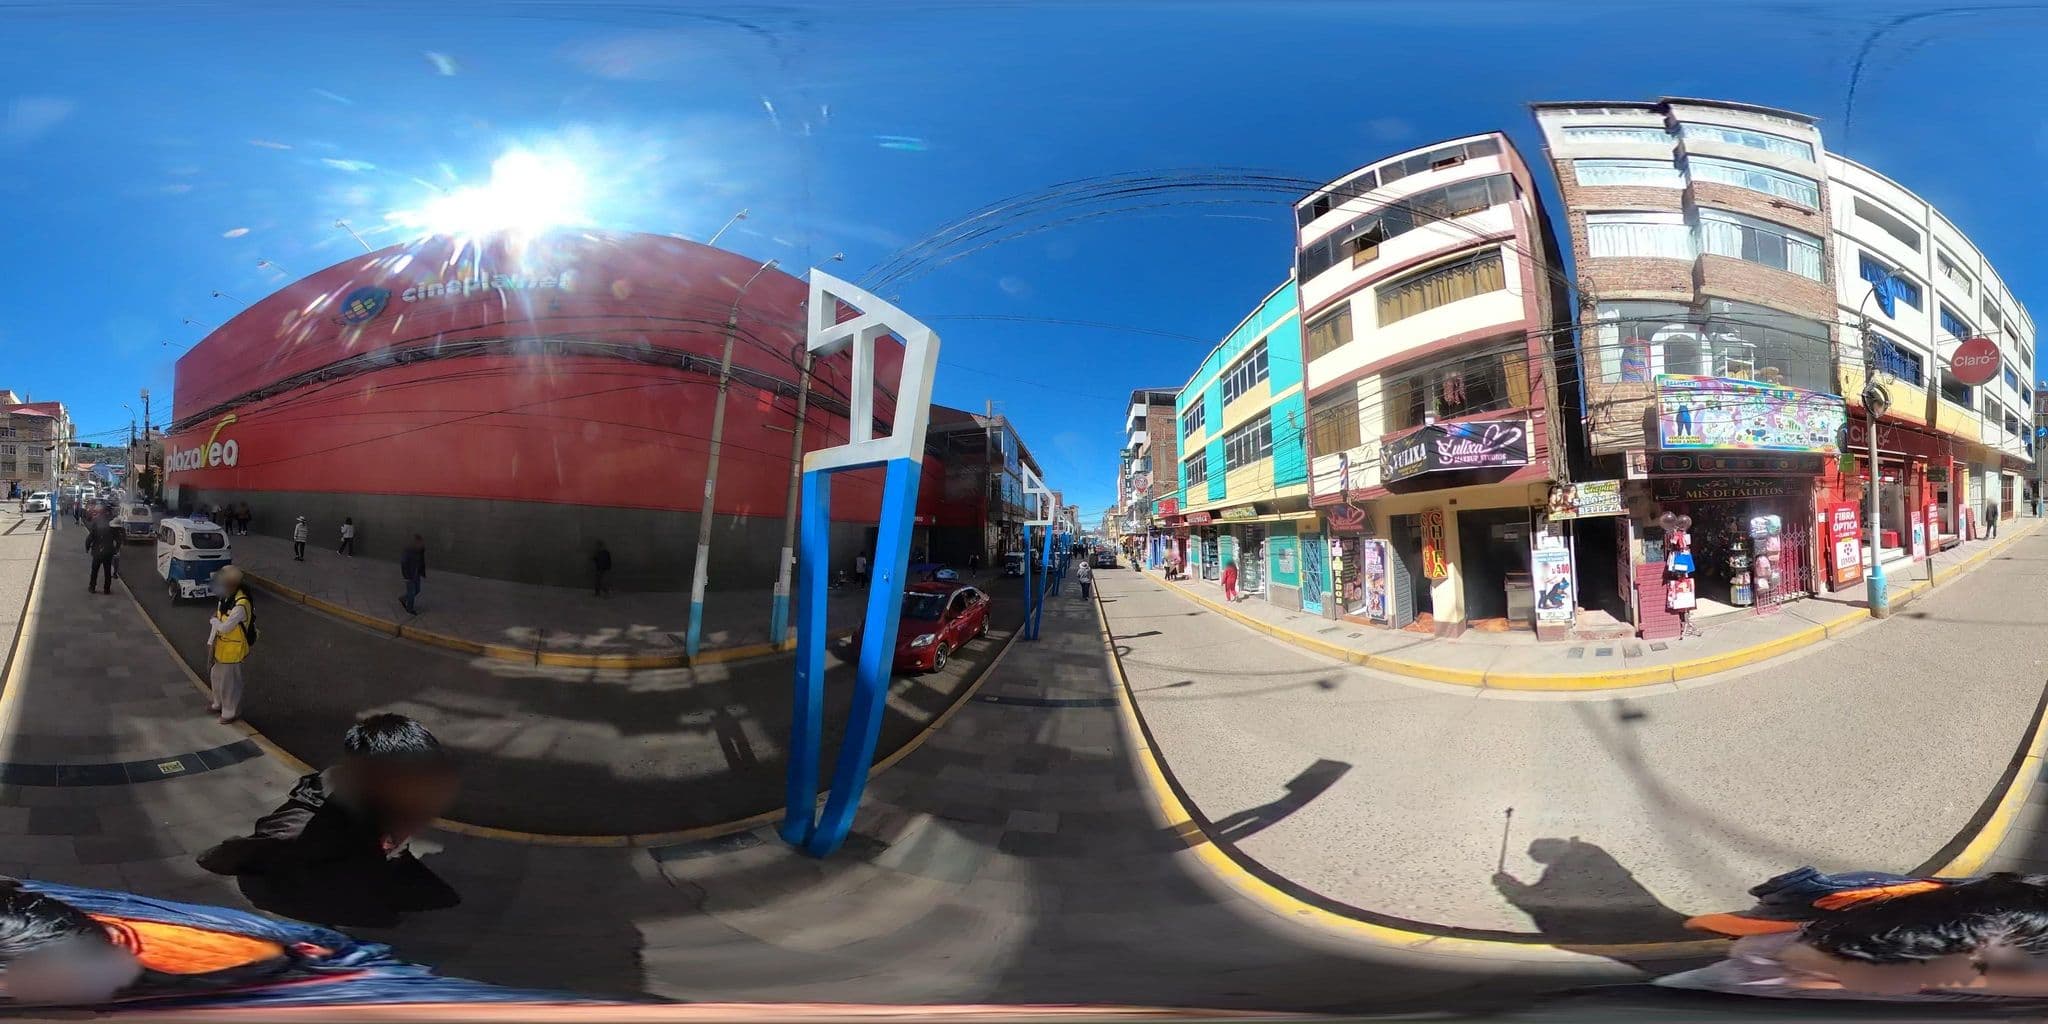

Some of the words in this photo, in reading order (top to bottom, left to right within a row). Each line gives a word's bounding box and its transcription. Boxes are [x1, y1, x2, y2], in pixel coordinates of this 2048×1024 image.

[1953, 353, 1993, 367] Claro
[1686, 490, 1710, 499] MIS
[1578, 504, 1623, 515] BELLEZA
[1834, 511, 1855, 522] FIBRA
[1431, 512, 1447, 578] CHIFA
